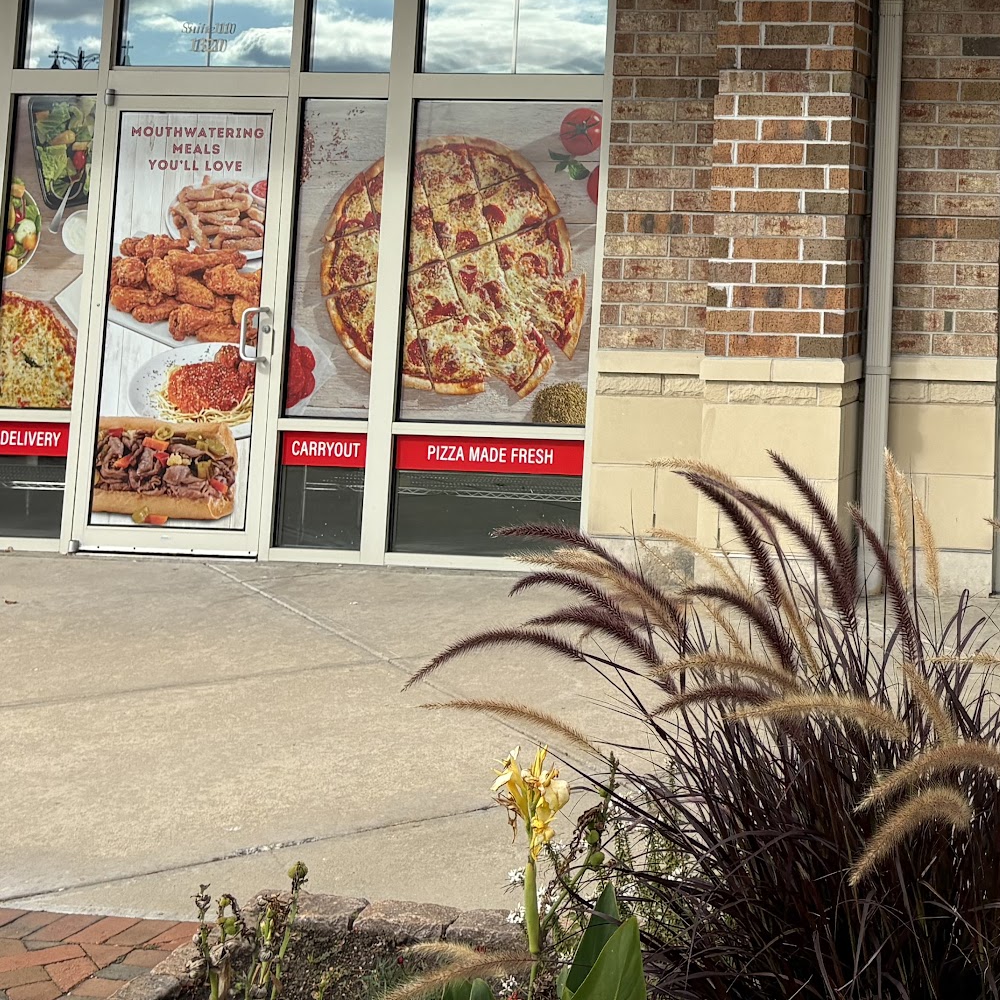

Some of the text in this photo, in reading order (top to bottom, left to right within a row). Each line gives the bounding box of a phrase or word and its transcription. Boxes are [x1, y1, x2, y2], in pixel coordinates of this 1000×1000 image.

[131, 126, 265, 139] MOUTHWATERING
[172, 143, 221, 154] MEALS
[148, 159, 243, 171] YOU'LL LOVE
[0, 430, 62, 447] DELIVERY
[291, 440, 361, 458] CARRYOUT
[427, 445, 554, 464] PIZZA MADE FRESH
